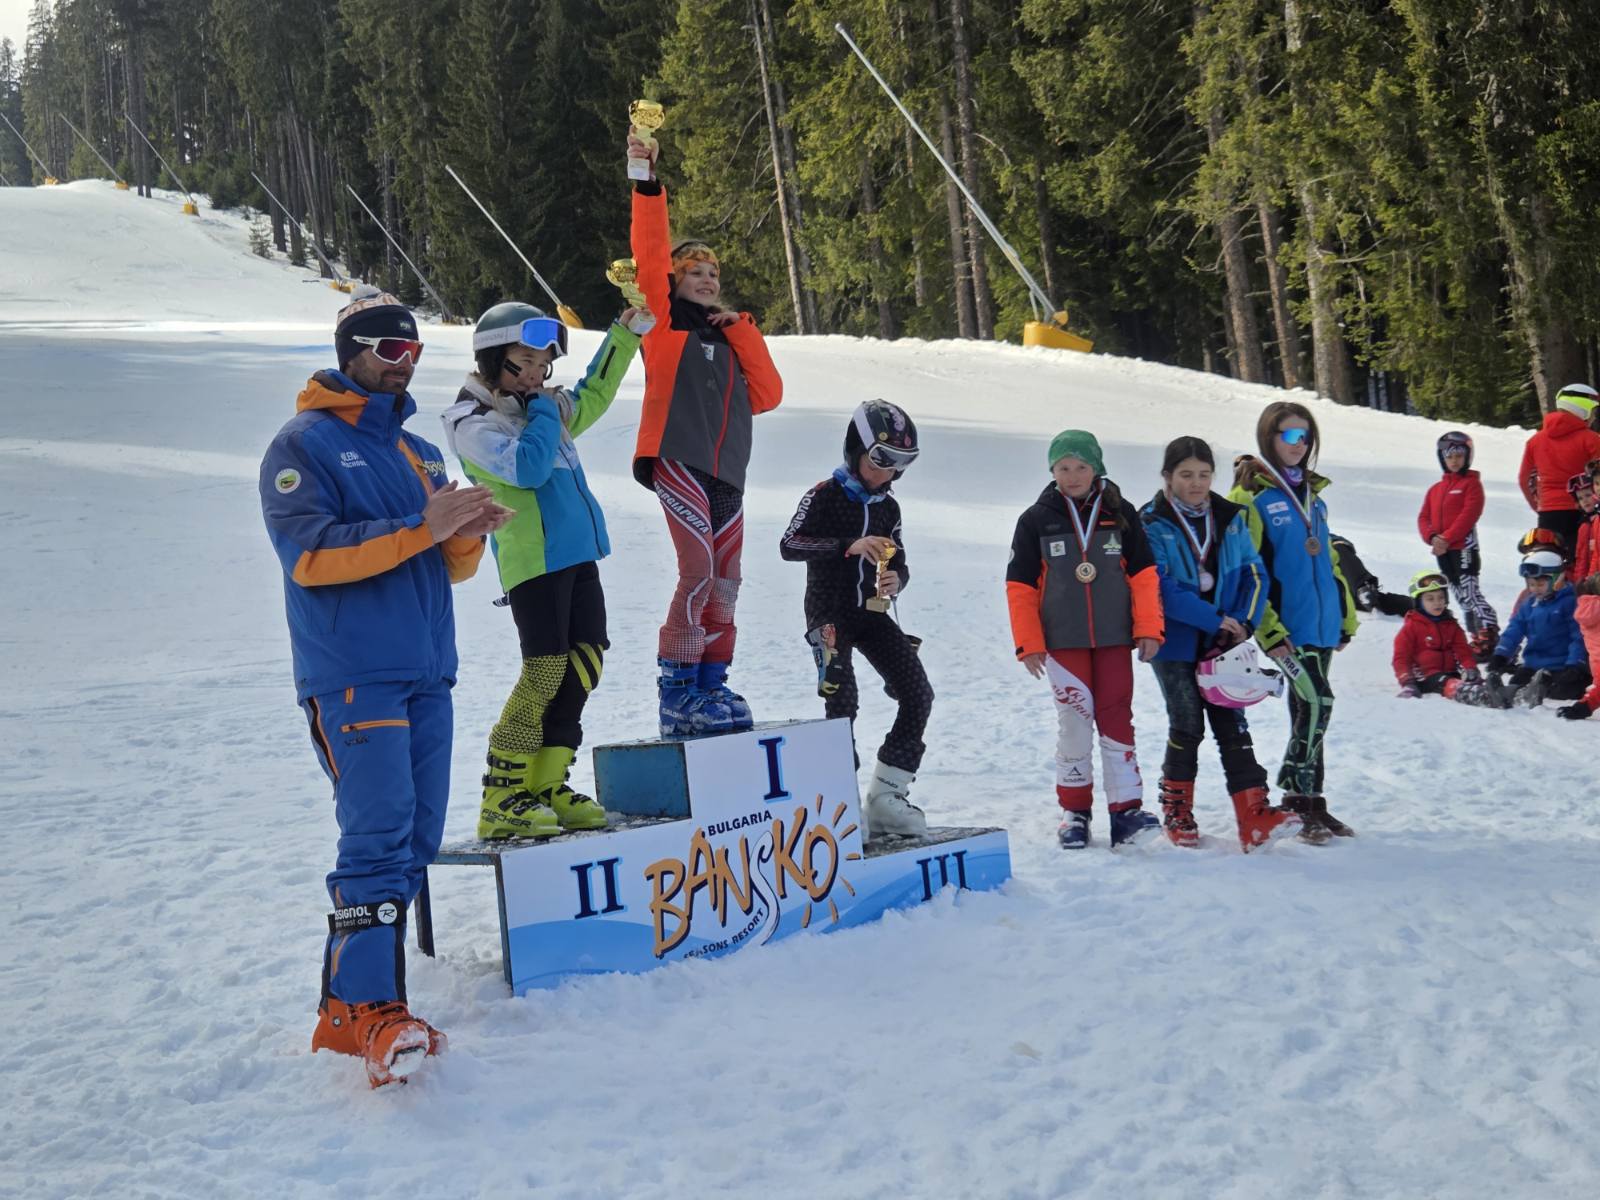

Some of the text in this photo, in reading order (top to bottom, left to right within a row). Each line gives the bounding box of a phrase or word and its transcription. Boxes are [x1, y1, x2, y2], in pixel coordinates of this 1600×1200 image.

[757, 737, 788, 801] I
[481, 808, 532, 829] FISCHER
[708, 810, 773, 836] BULGARIA
[570, 858, 624, 919] II
[644, 806, 839, 960] BANSKO
[917, 850, 970, 901] III
[731, 908, 764, 944] RESORT
